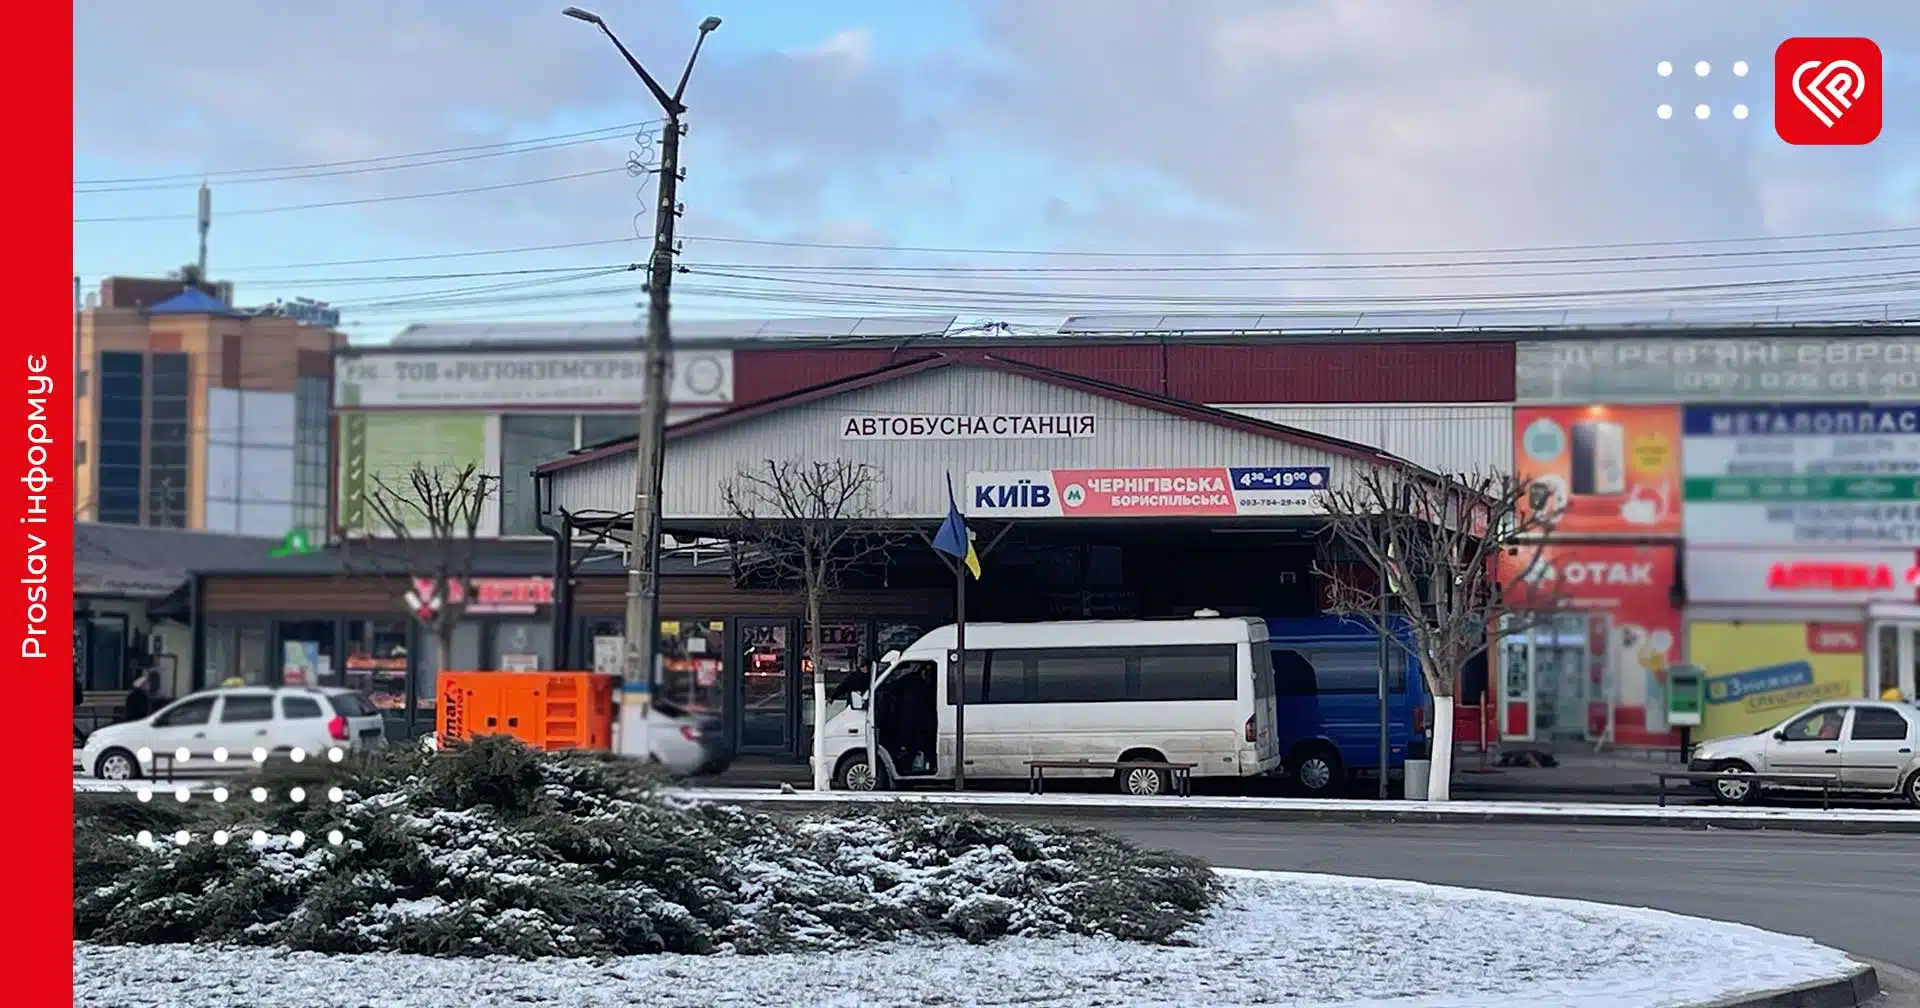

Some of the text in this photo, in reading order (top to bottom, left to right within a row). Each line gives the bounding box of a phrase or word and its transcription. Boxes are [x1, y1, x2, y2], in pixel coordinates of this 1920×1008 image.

[844, 415, 1095, 437] АВТОБУСНА СТАНЦІЯ
[975, 479, 1051, 508] КИЇВ
[1087, 477, 1225, 494] ЧЕРНІГІВСЬКА
[1111, 494, 1230, 507] БОРИСПІЛЬСЬКА
